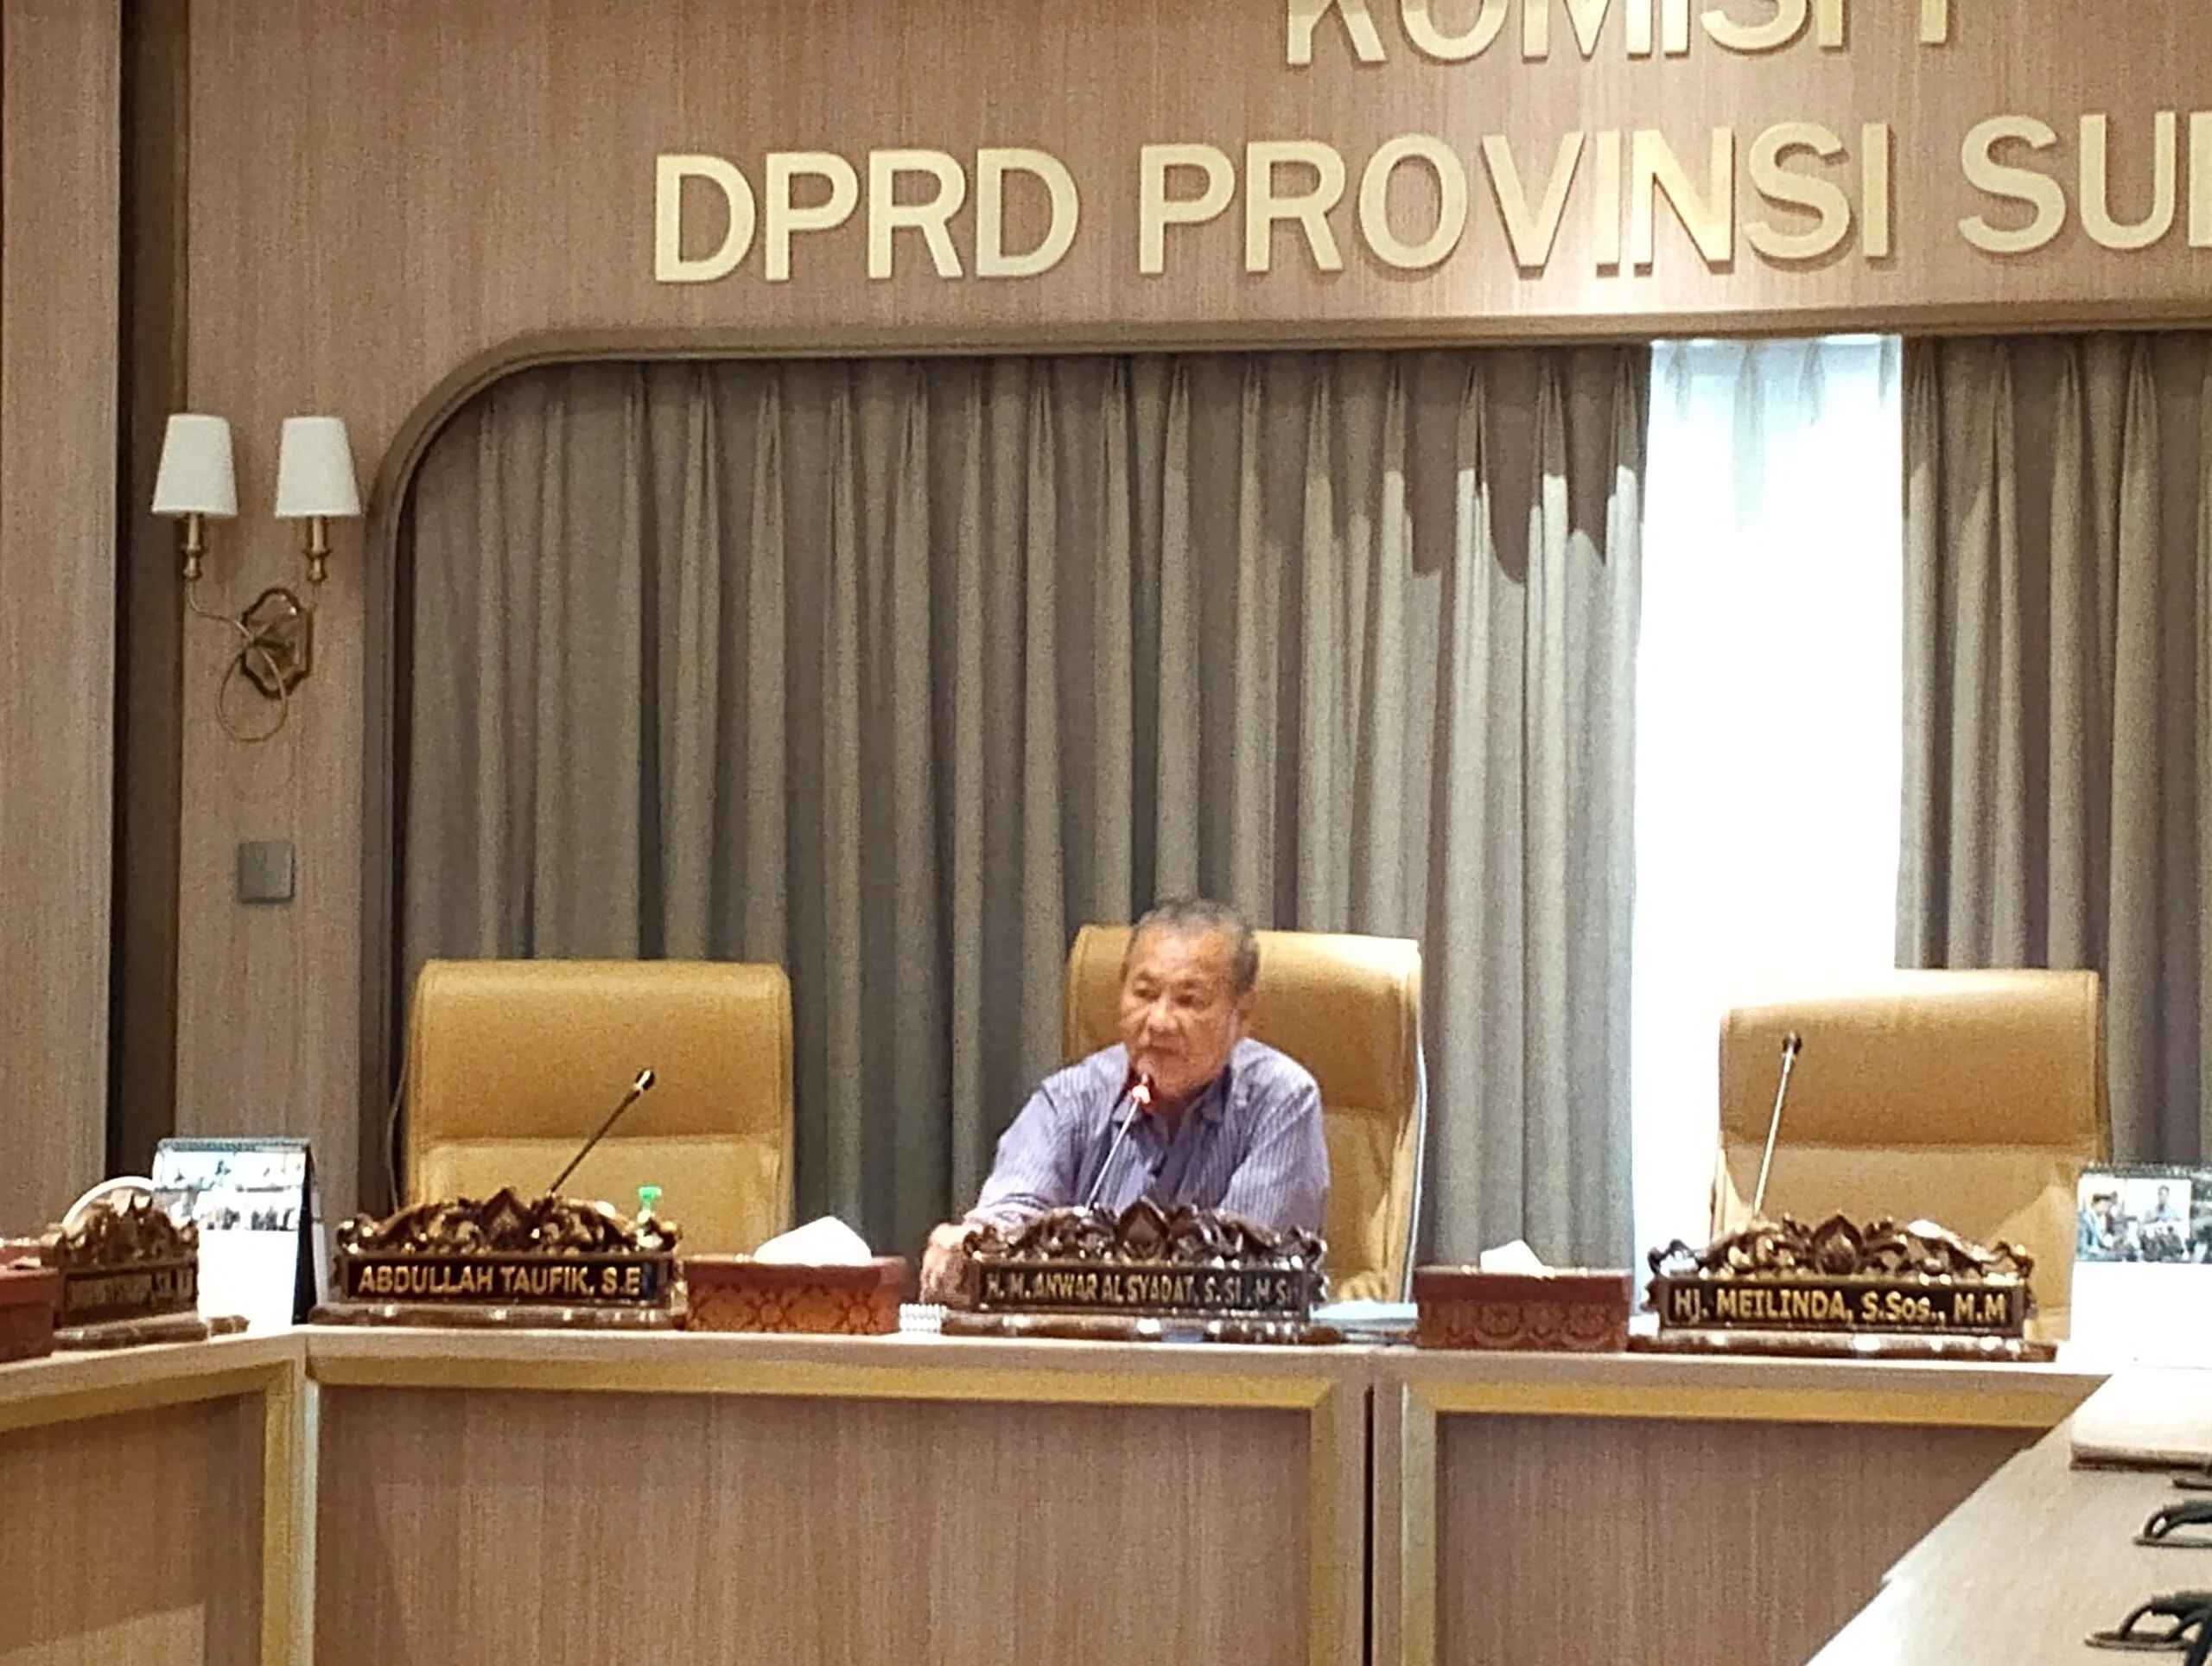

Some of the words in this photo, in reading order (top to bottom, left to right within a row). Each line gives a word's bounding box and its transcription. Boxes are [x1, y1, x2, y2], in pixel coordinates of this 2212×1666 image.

[654, 147, 1080, 283] DPRD
[1139, 122, 1890, 275] PROVINSI
[1957, 111, 2212, 252] SU
[357, 1265, 493, 1294] ABDULLAH
[499, 1266, 594, 1295] TAUFIK,
[1033, 1272, 1097, 1300] ANWAR
[1102, 1274, 1123, 1303] AL
[1954, 1292, 2006, 1323] M.M
